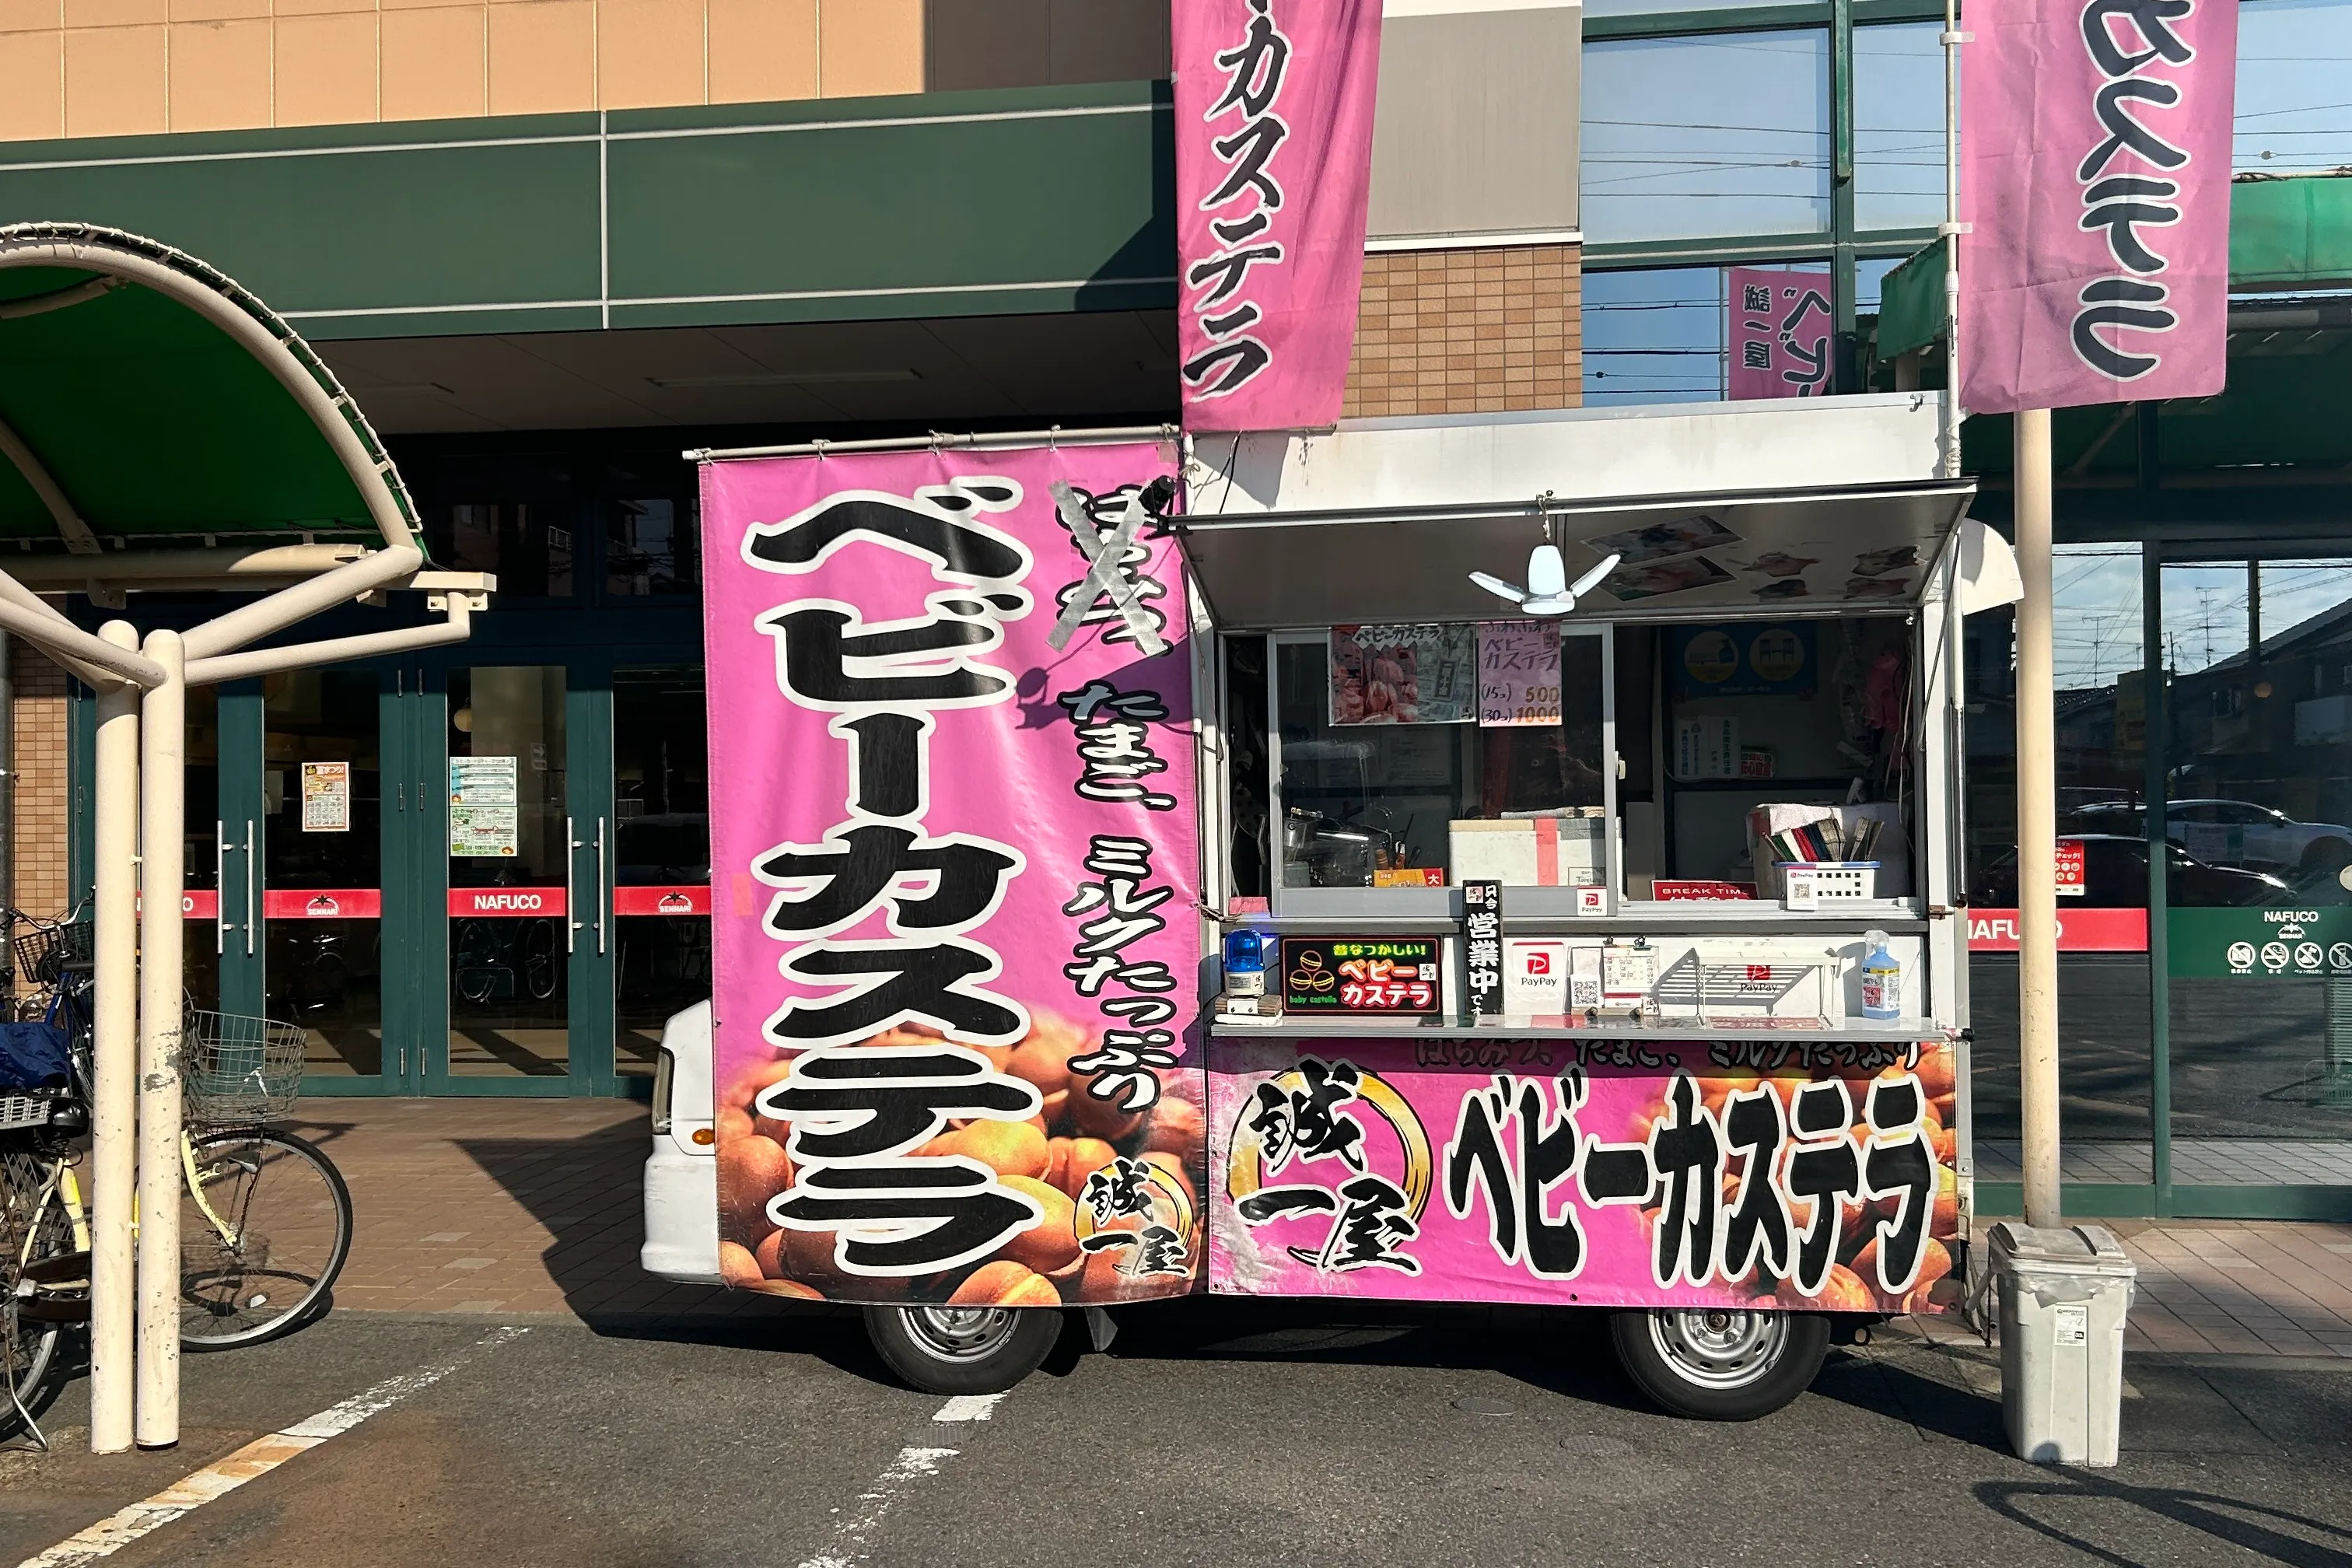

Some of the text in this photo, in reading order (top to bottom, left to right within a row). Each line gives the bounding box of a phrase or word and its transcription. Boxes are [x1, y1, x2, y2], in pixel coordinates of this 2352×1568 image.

[1179, 0, 1293, 404] カステラ
[1484, 637, 1538, 651] ベビー
[1483, 650, 1559, 671] カステラ
[1524, 686, 1559, 704] 500
[1516, 706, 1559, 723] 1000
[743, 476, 1046, 1279] ベビーカステラ
[1427, 873, 1440, 885] 大
[474, 894, 542, 910] NAFUCO
[2263, 911, 2319, 922] NAFUCO
[1467, 912, 1500, 995] 営業中
[1062, 834, 1178, 1114] ミルクたっぷり
[1339, 960, 1418, 983] ベビー
[1521, 977, 1558, 987] PayPay
[1740, 982, 1777, 992] PayPay
[1341, 983, 1433, 1007] カステラ
[1447, 1067, 1933, 1295] ベビーカステラ
